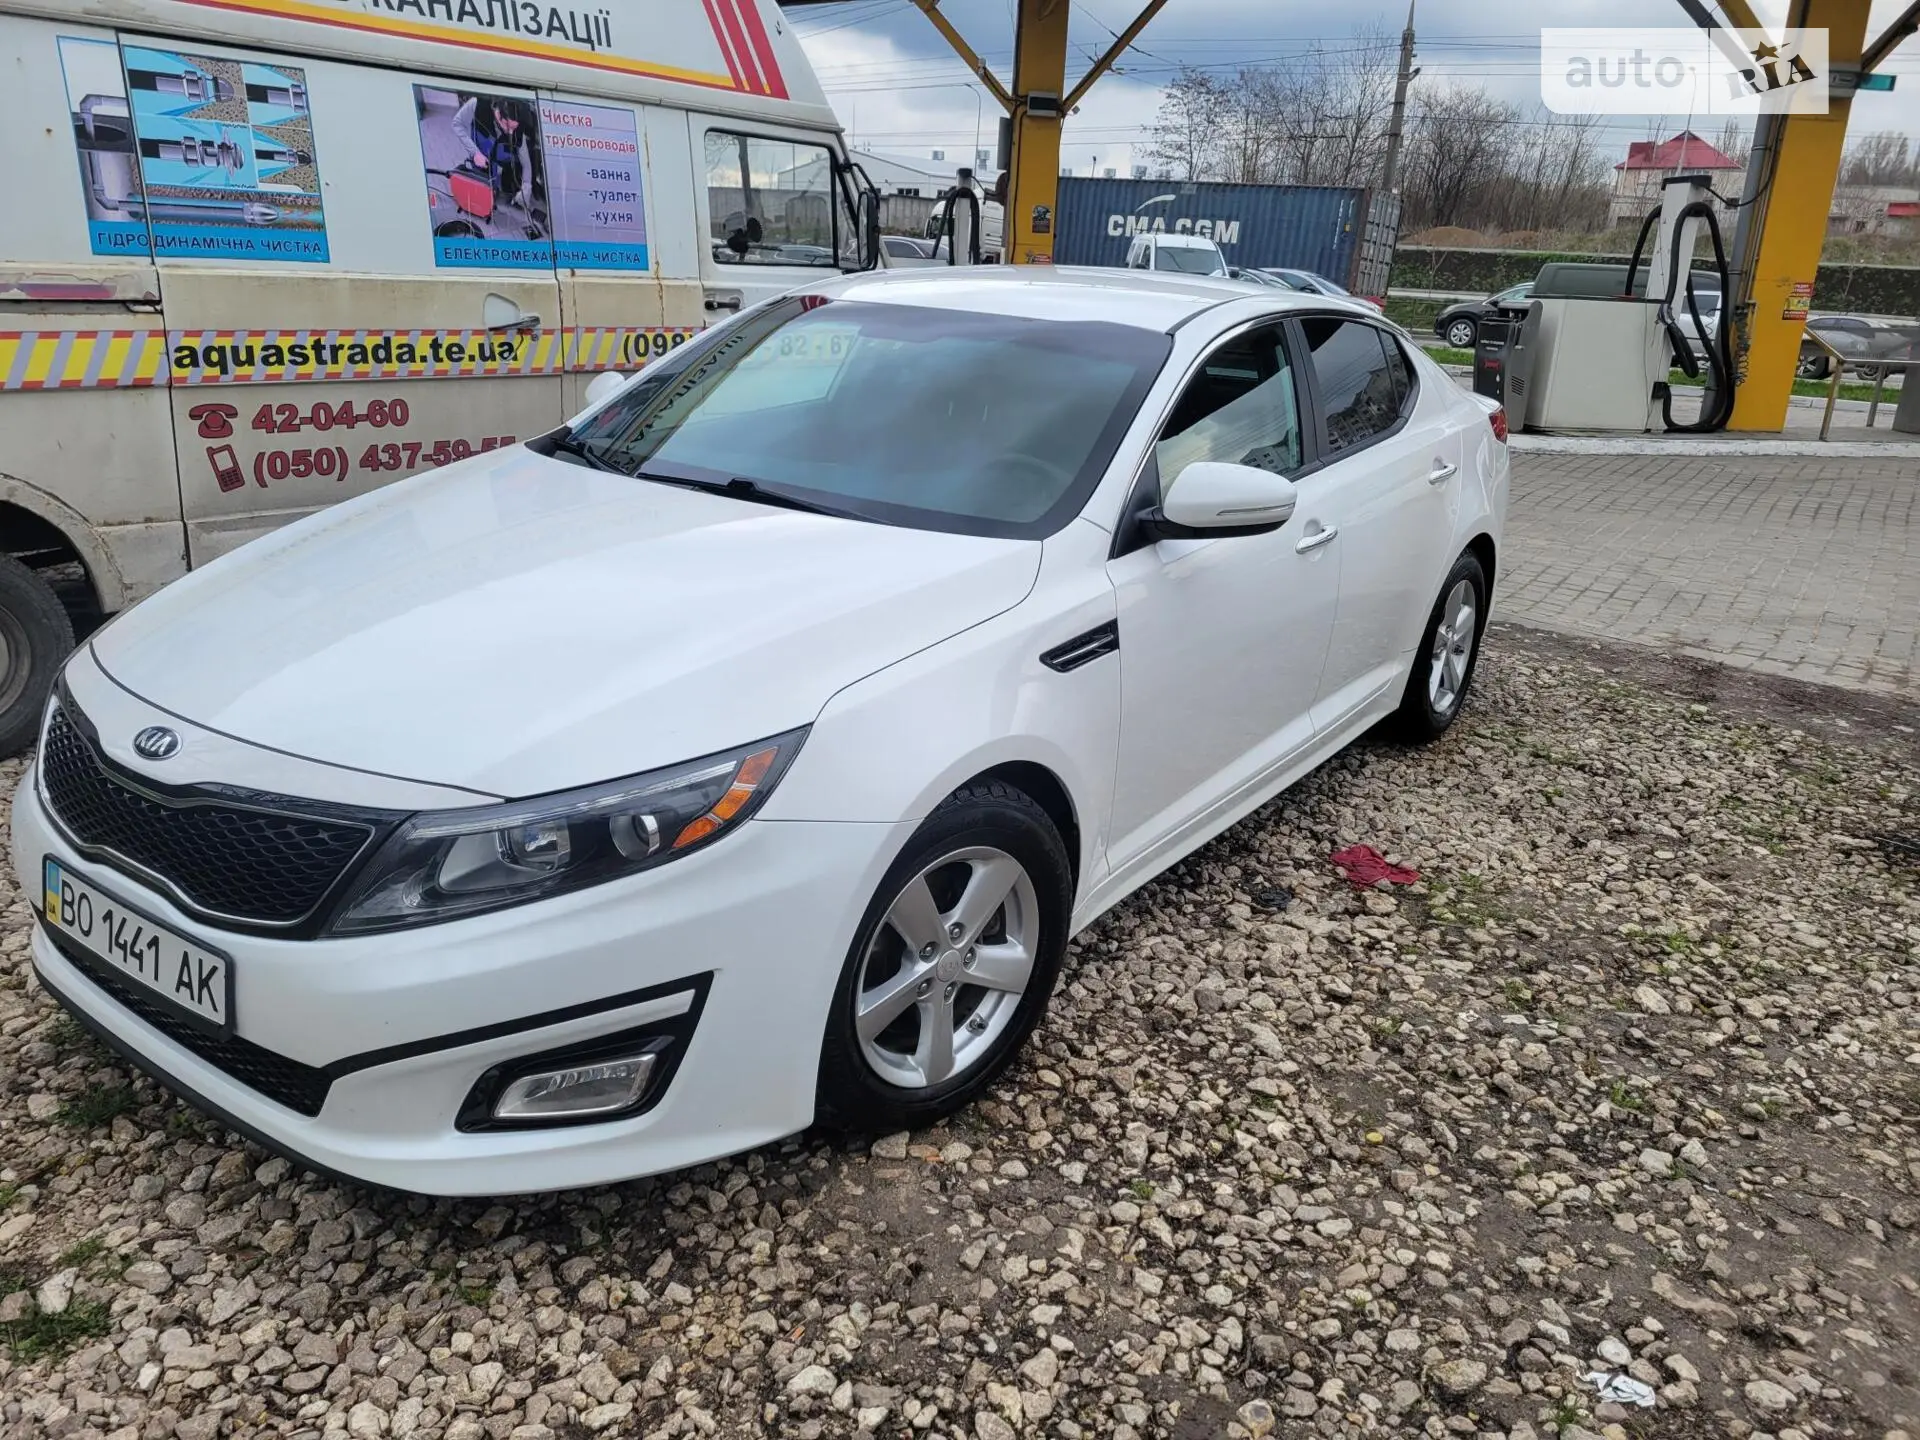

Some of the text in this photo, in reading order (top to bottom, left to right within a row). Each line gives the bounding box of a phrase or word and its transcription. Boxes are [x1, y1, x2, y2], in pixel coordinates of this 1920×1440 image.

[371, 0, 612, 51] НАЛІЗАЦІЇ
[542, 108, 593, 127] Чистка
[545, 134, 637, 153] трубопроводів
[1107, 214, 1240, 244] CMA CGM
[260, 239, 322, 253] ЧИСТКА
[592, 251, 641, 264] ЧИСТКА
[173, 336, 520, 376] aquastrada.te.ua
[622, 333, 694, 364] (098
[251, 398, 410, 434] 42-04-60
[253, 446, 350, 489] (050)
[102, 908, 160, 982] 1441
